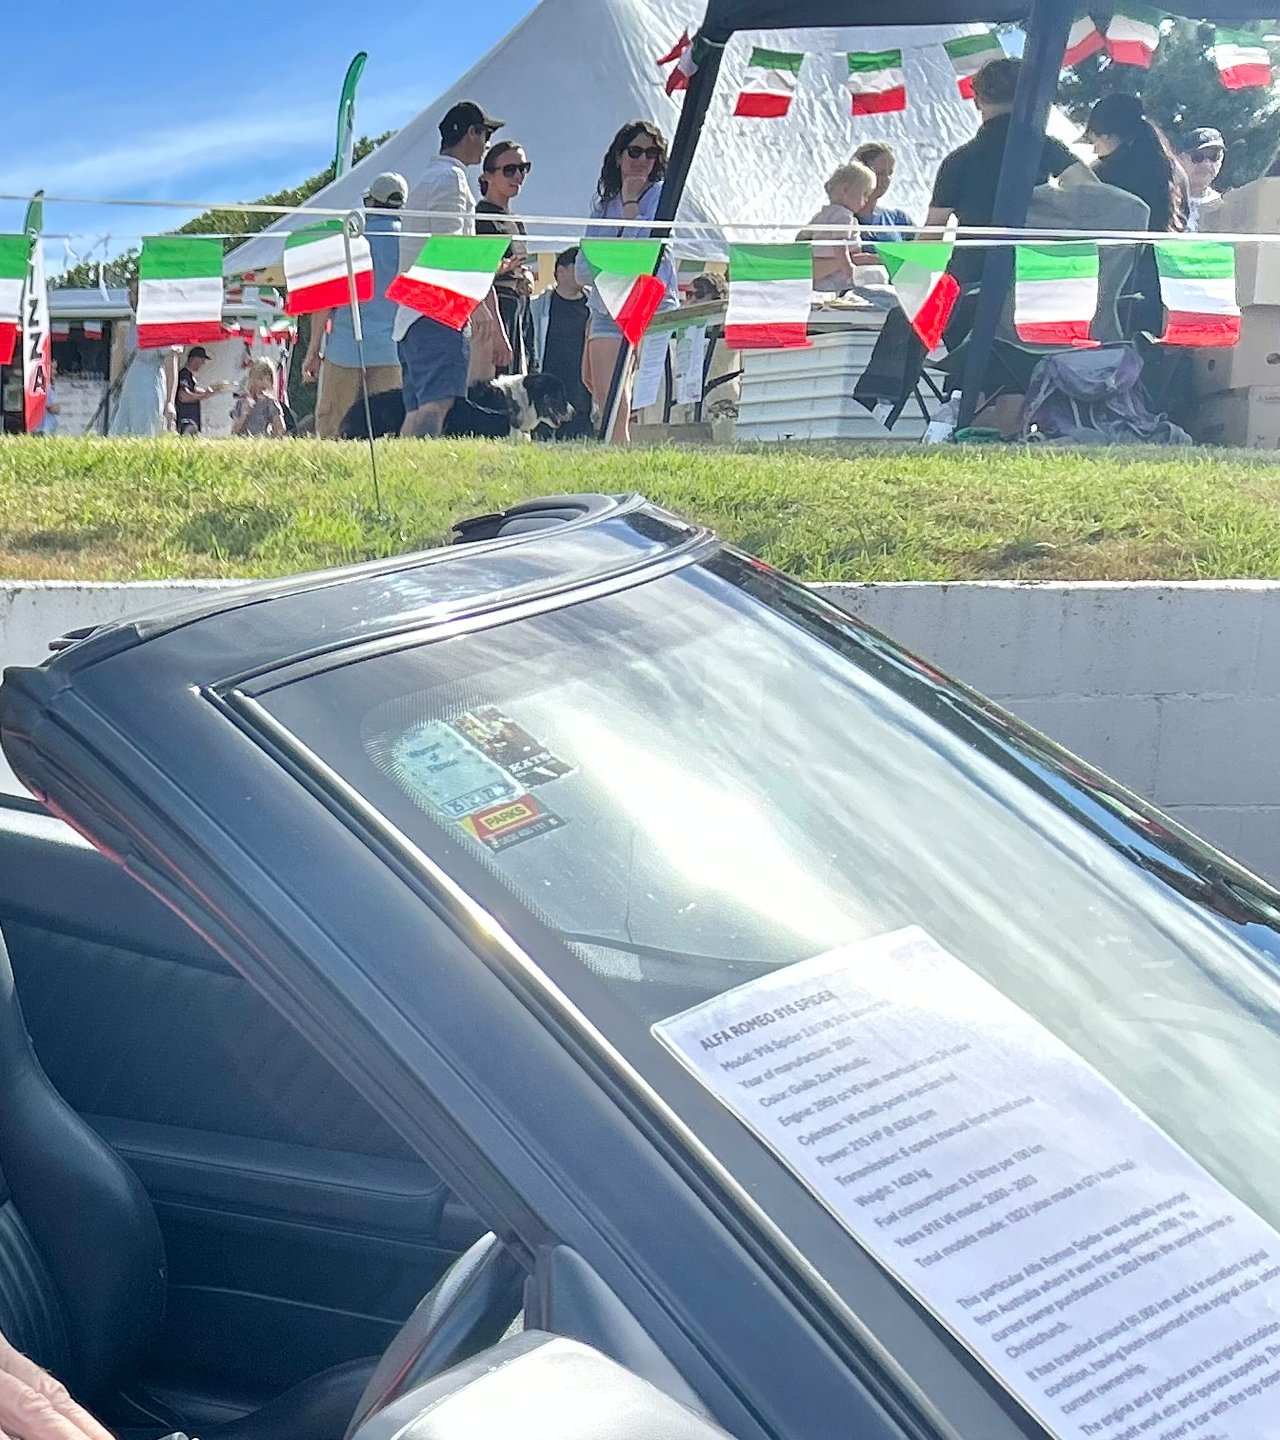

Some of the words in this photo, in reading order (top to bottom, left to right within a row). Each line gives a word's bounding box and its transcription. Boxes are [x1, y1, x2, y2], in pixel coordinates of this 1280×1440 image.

[485, 806, 527, 828] PARKS
[699, 1030, 732, 1051] ALFA
[729, 1012, 775, 1036] ROMEO
[793, 989, 838, 1010] SPIDER
[737, 1075, 763, 1088] Year
[815, 1146, 852, 1165] Power:
[908, 1135, 938, 1153] speed
[873, 1211, 899, 1228] Fuel
[893, 1230, 925, 1247] Years
[913, 1250, 943, 1268] Total
[941, 1234, 978, 1256] models
[955, 1295, 980, 1309] This
[979, 1273, 1024, 1300] particular
[1022, 1263, 1044, 1276] Alfa
[1039, 1246, 1076, 1266] Romeo
[1071, 1233, 1103, 1250] Spider
[972, 1309, 999, 1325] from
[997, 1288, 1041, 1313] Australia
[1039, 1273, 1069, 1292] where
[991, 1319, 1027, 1342] current
[1026, 1304, 1055, 1324] owner
[1054, 1278, 1104, 1310] purchased
[1053, 1337, 1097, 1365] travelled
[1095, 1320, 1129, 1344] around
[1088, 1349, 1126, 1371] having
[1119, 1337, 1146, 1354] been
[1100, 1403, 1134, 1426] engine
[1151, 1373, 1188, 1399] gearbox
[1211, 1340, 1245, 1363] original
[1060, 1389, 1097, 1414] current
[1138, 1412, 1163, 1430] work
[1195, 1374, 1232, 1398] operate
[1209, 1400, 1231, 1416] with
